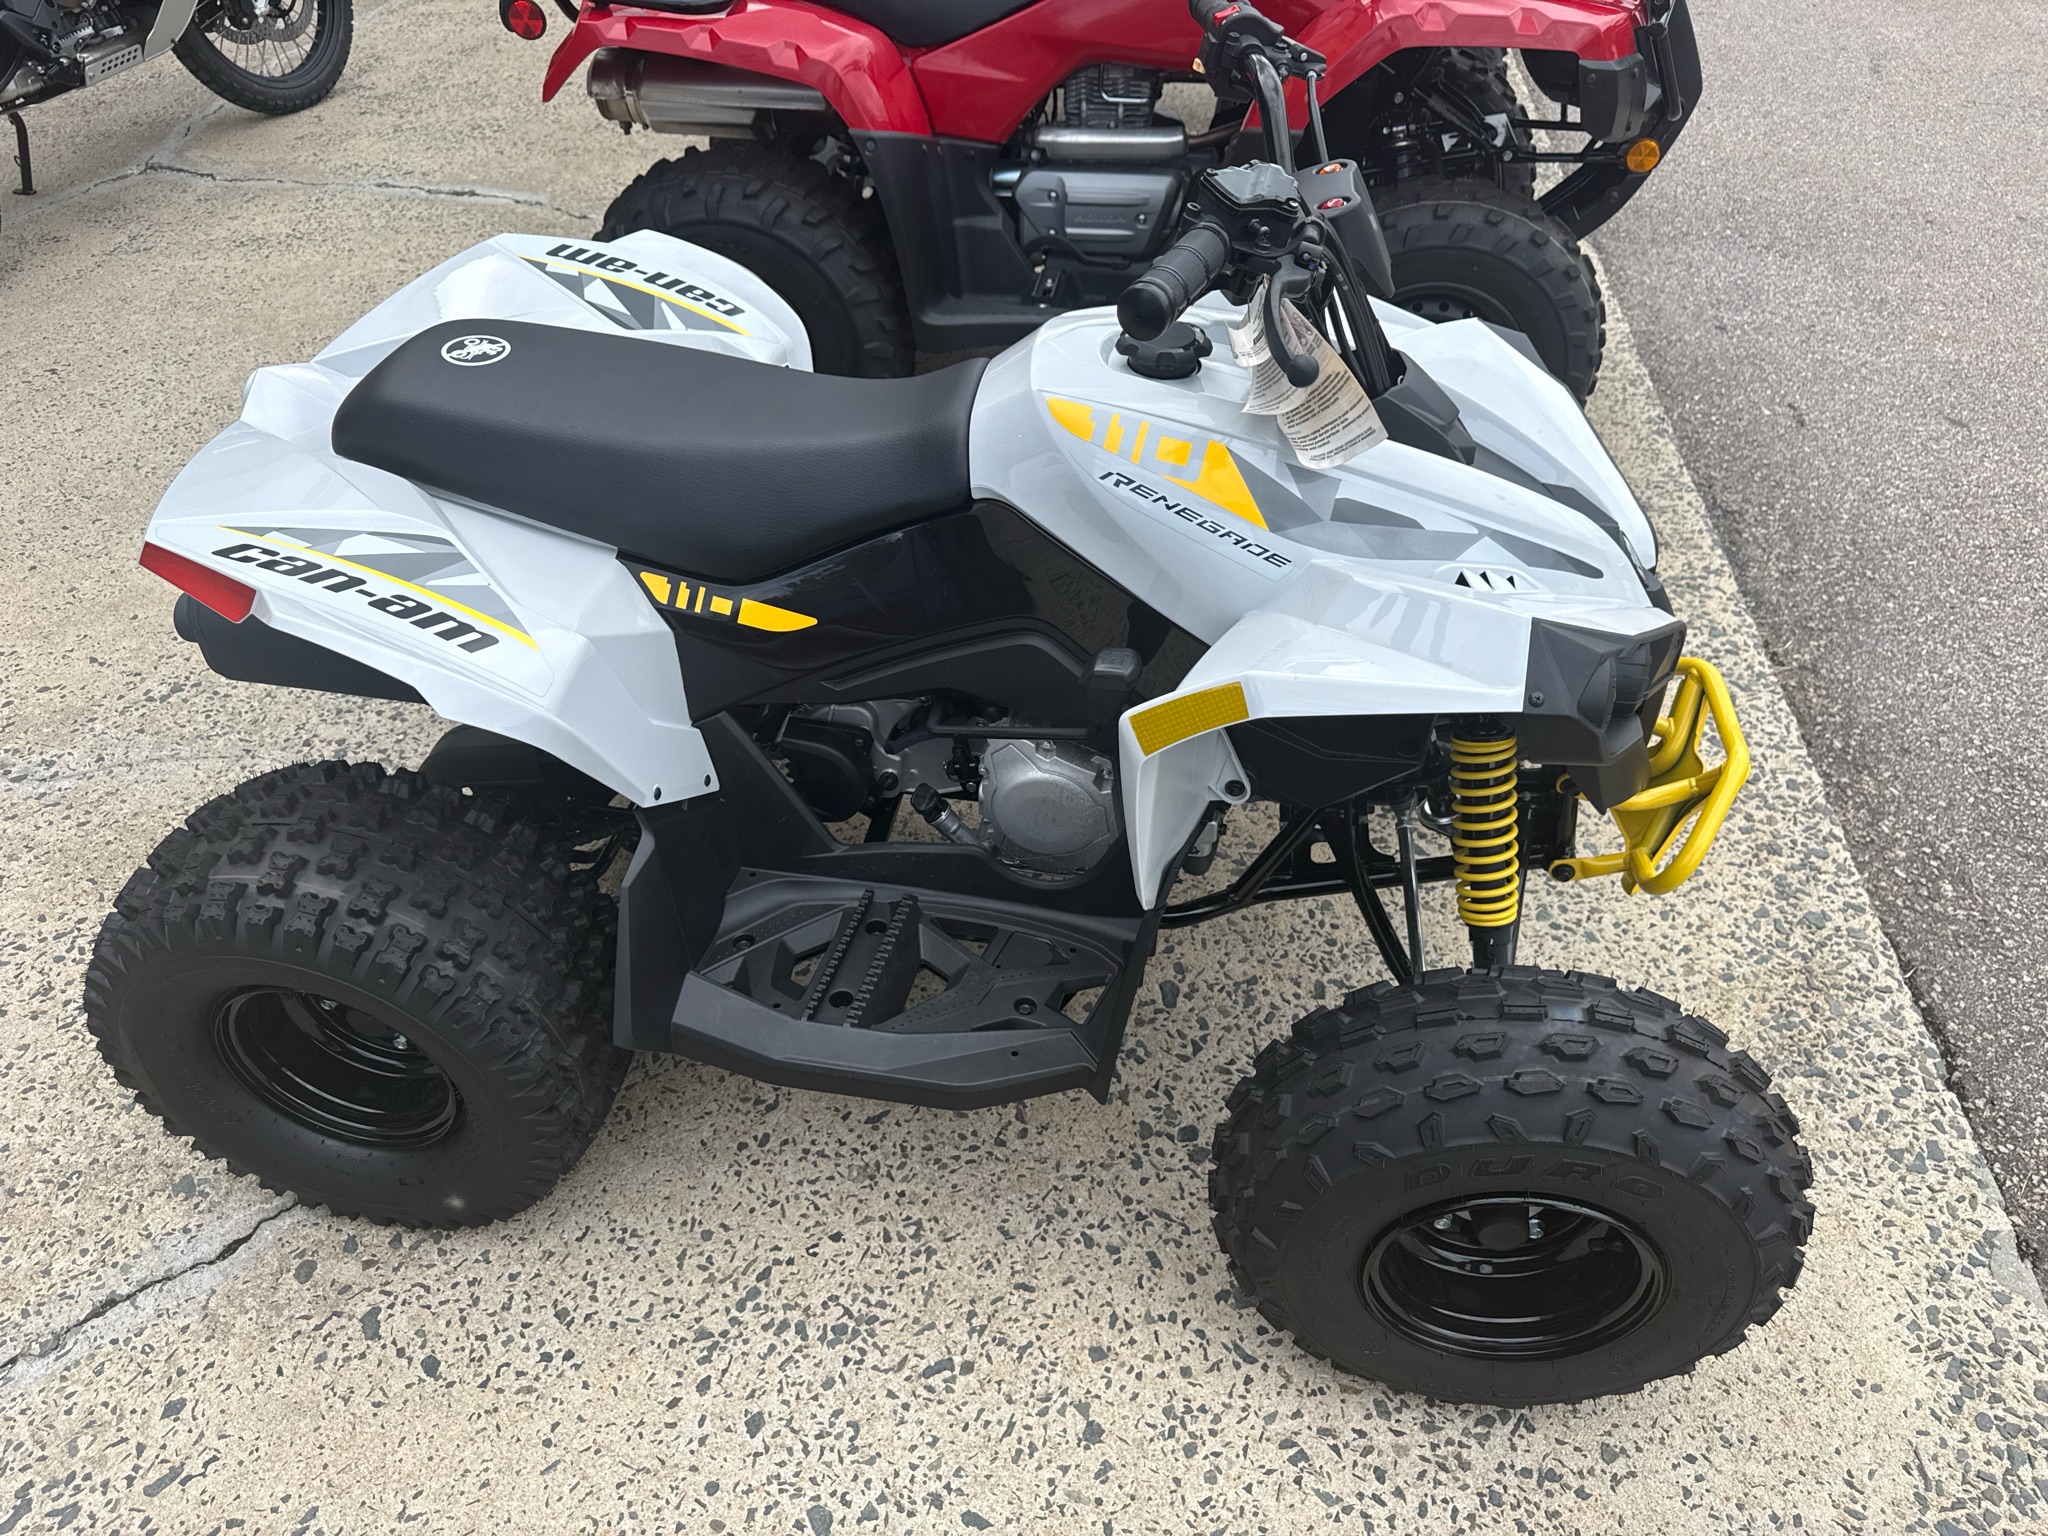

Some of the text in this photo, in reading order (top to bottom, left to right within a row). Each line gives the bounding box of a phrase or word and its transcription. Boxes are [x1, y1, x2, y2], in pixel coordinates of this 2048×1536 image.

[545, 243, 746, 317] can-am
[1098, 470, 1293, 568] RENEGADE
[210, 543, 500, 654] can-am
[1404, 1153, 1666, 1200] DURO
